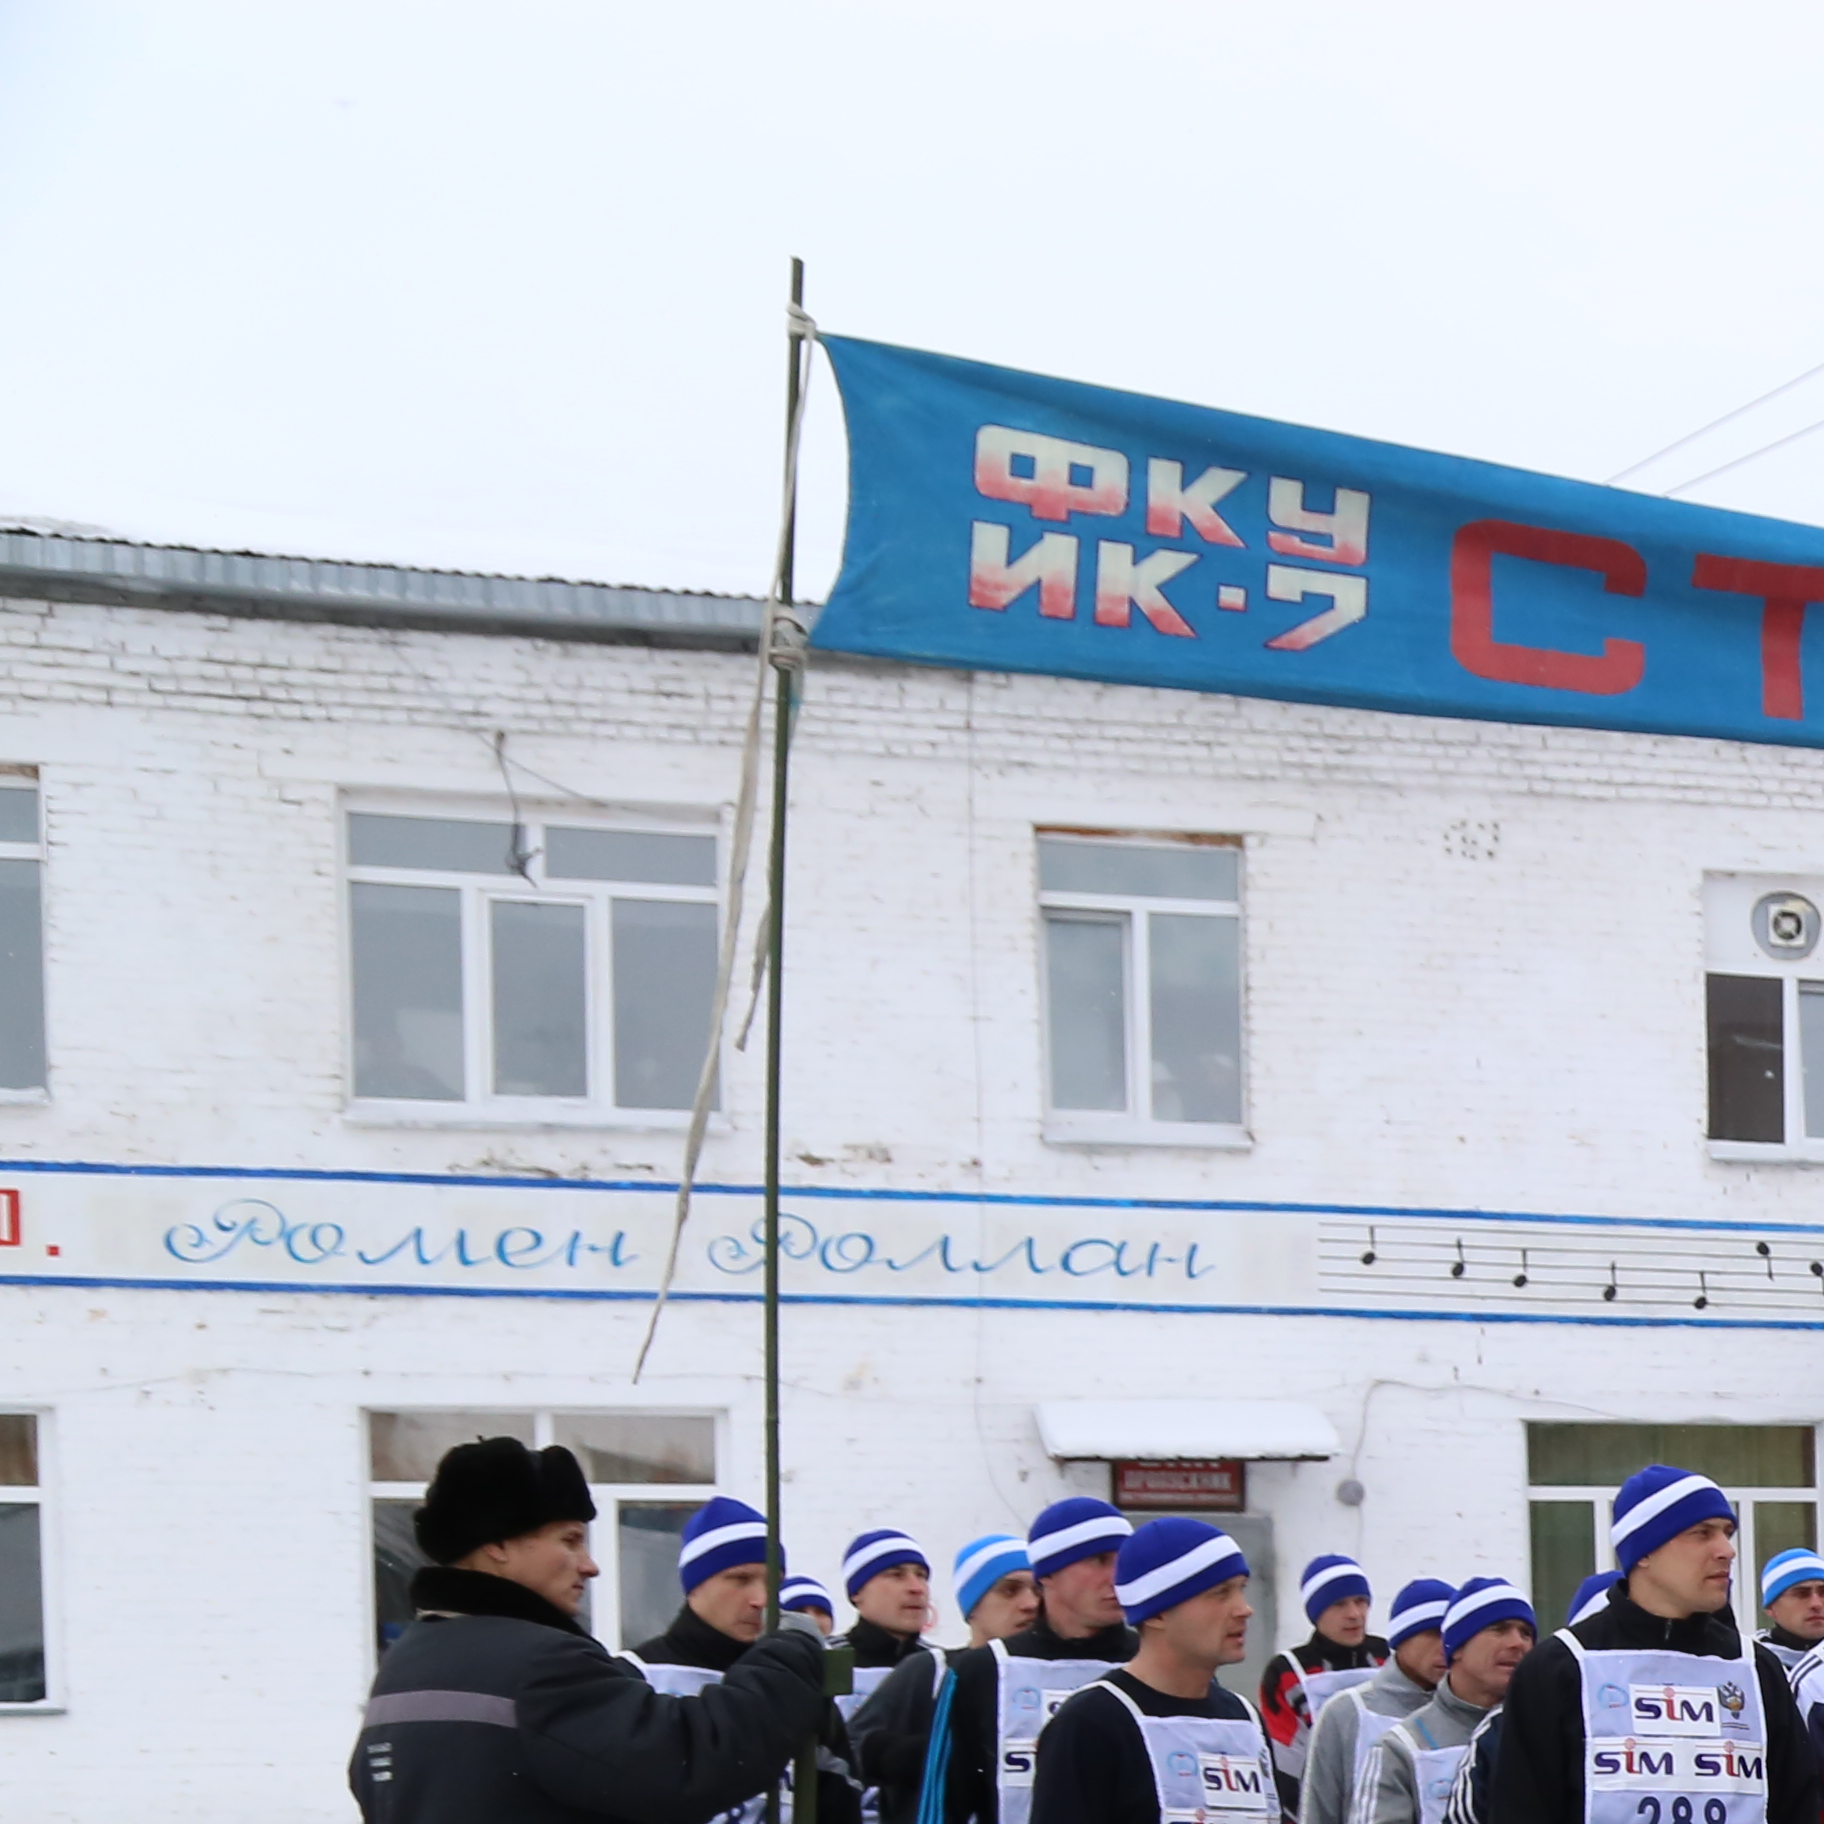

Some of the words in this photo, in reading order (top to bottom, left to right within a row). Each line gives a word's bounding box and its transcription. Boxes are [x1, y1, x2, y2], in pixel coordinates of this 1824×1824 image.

[975, 423, 1371, 566] ФКУ
[164, 1198, 638, 1268] Ромен
[707, 1212, 1217, 1280] Роллан
